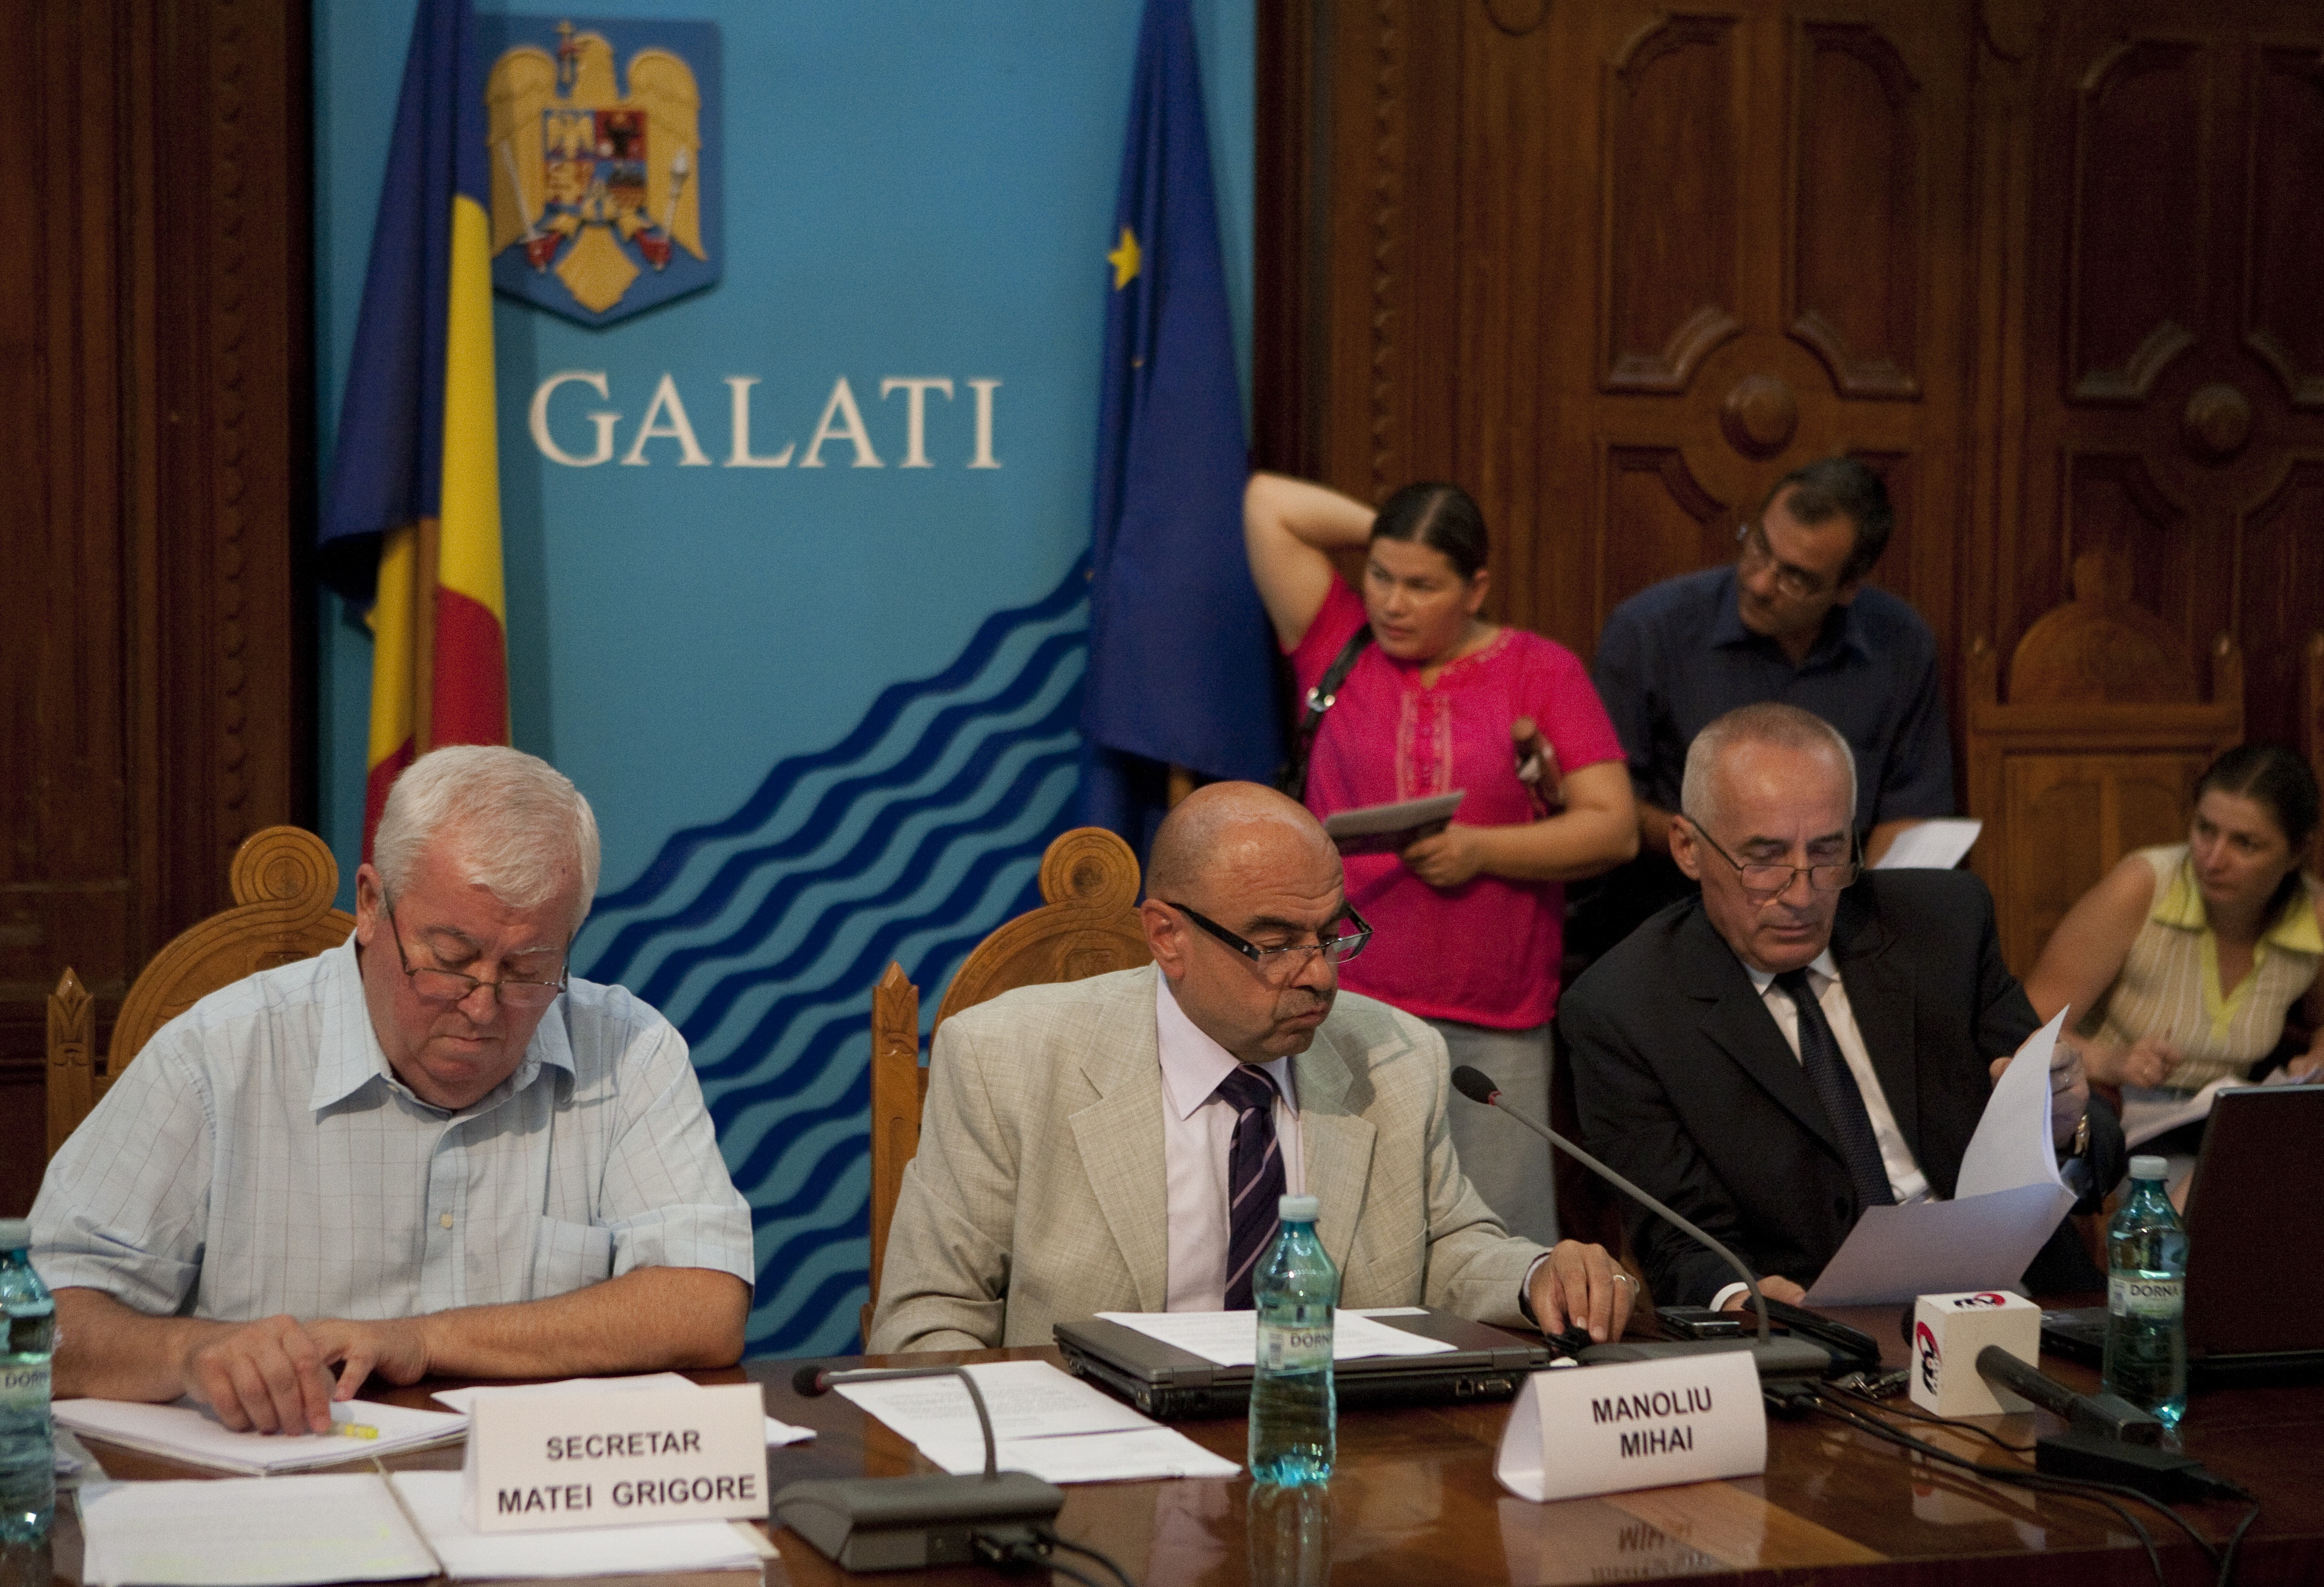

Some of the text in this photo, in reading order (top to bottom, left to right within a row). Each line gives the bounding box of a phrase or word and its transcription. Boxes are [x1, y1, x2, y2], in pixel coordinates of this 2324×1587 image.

[527, 369, 1003, 467] GALATI
[1591, 1386, 1713, 1424] MANOLIU
[545, 1430, 702, 1461] SECRETAR
[1619, 1425, 1694, 1458] MIHAI
[497, 1473, 758, 1515] MATEI GRIGORE
